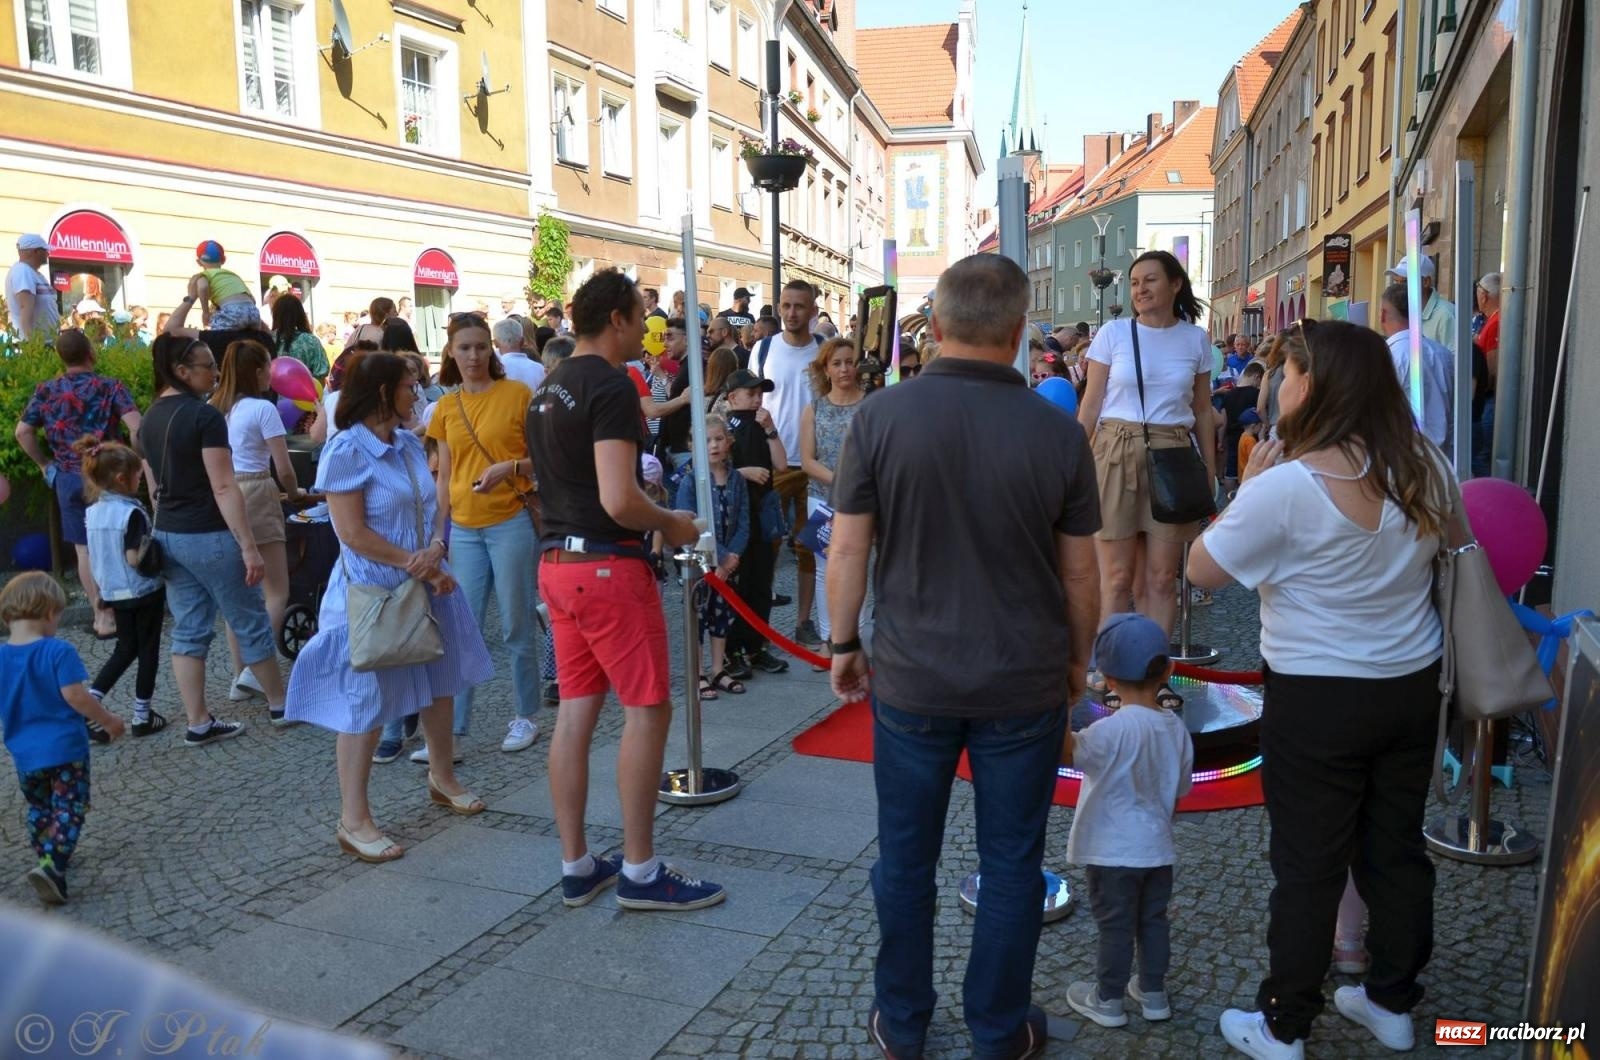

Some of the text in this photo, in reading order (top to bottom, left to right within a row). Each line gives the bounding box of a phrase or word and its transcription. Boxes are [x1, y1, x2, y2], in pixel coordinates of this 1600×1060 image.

[55, 231, 127, 253] Millennium
[264, 250, 316, 269] Millennium
[417, 264, 456, 280] Millennium
